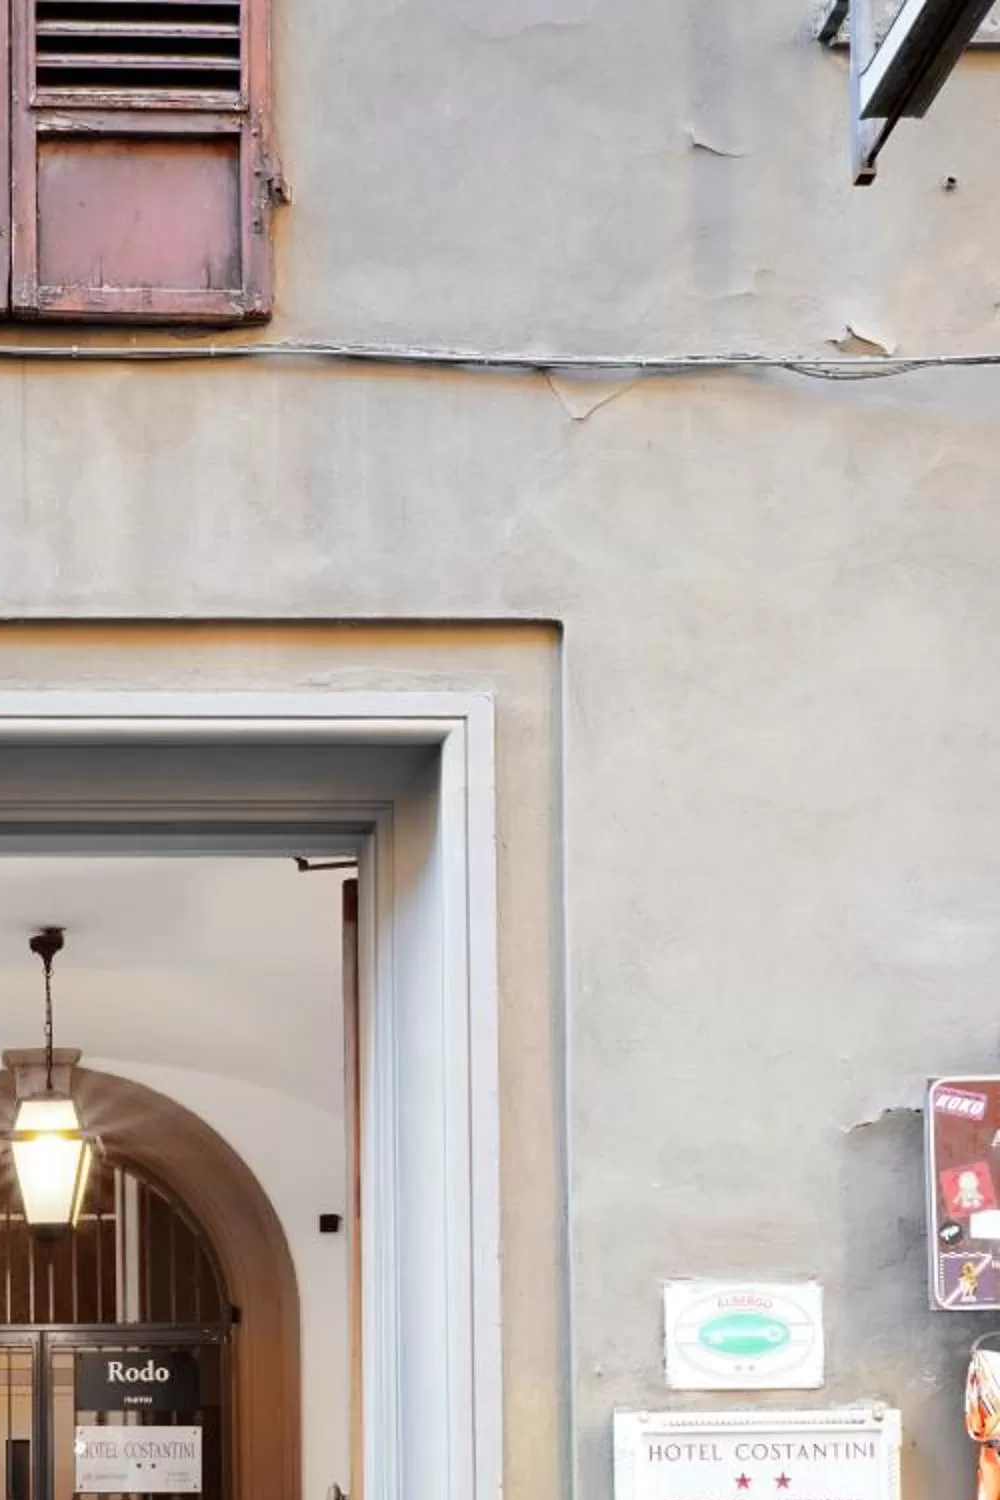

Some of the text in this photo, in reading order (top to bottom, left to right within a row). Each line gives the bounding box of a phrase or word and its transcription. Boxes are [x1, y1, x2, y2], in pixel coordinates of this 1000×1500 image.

[107, 1359, 170, 1382] Rodo
[123, 1440, 195, 1459] COSTANTINI
[648, 1442, 876, 1462] HOTEL COSTANTINI
